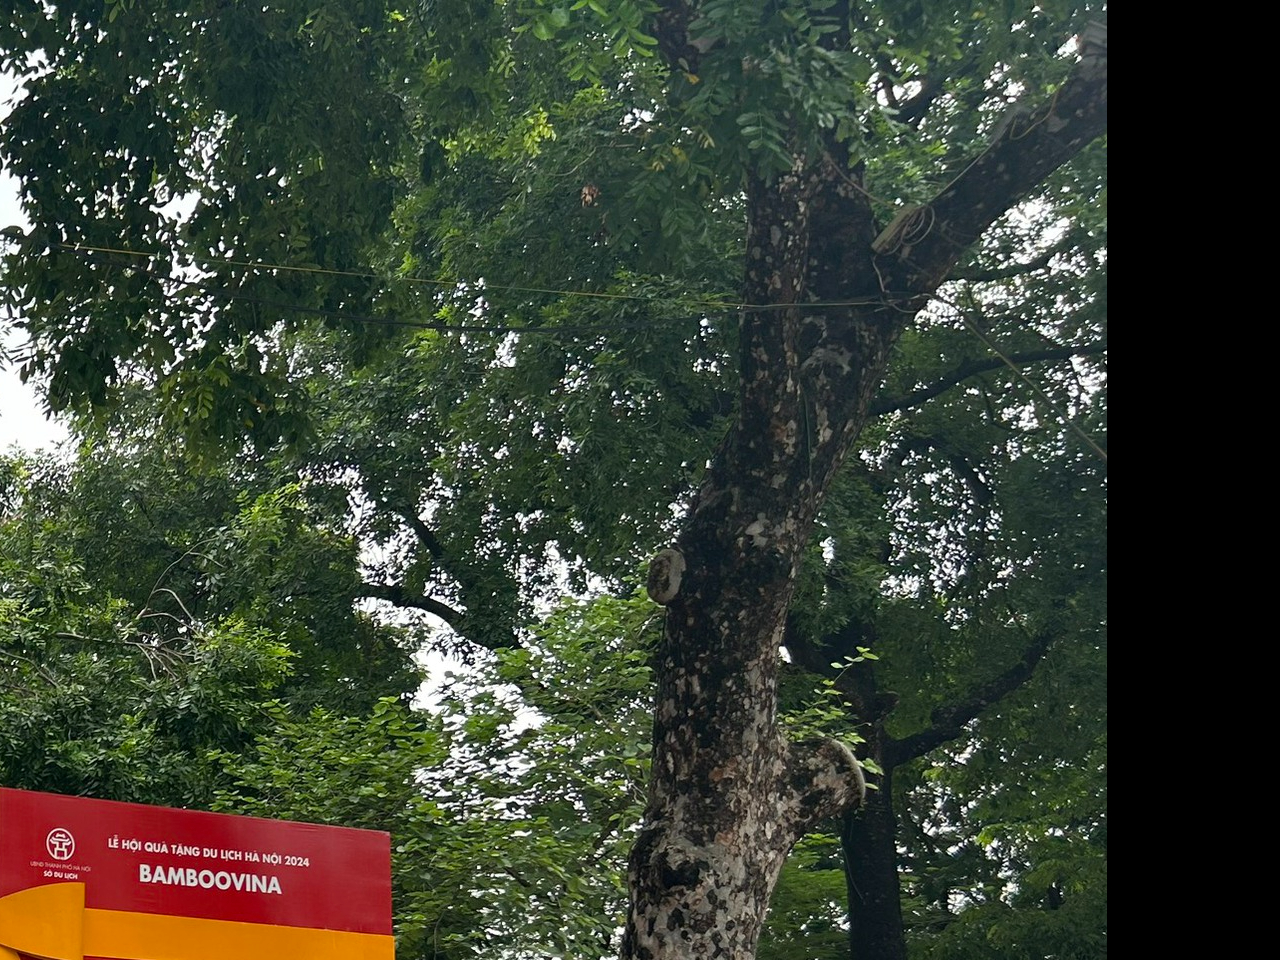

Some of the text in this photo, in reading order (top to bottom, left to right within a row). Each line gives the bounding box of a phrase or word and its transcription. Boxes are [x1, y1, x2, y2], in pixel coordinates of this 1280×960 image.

[108, 834, 310, 868] LỄ HỘI QUÀ TẶNG DU LỊCH HÀ NỘI 2024
[139, 864, 282, 894] BAMBOOVINA
